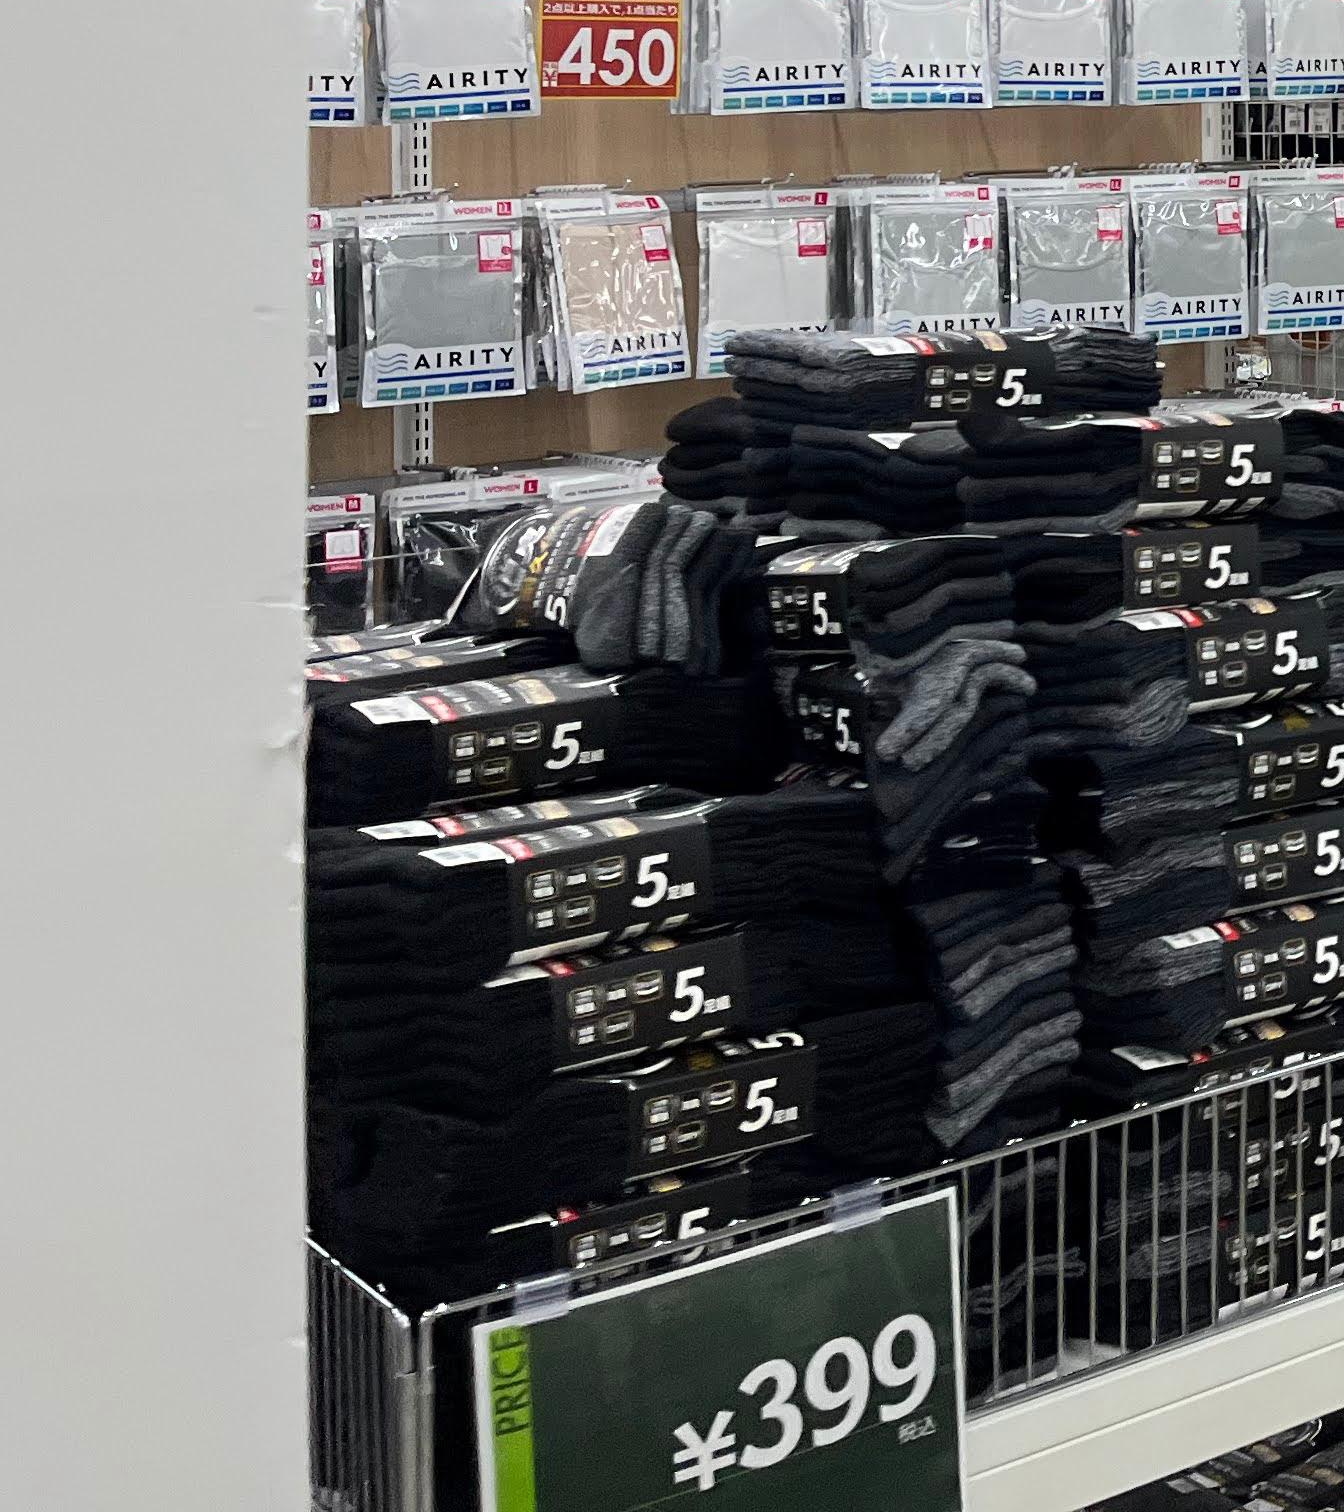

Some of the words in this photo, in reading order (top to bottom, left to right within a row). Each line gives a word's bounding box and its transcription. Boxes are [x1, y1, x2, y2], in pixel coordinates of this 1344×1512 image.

[755, 63, 845, 82] AIRITY
[902, 62, 982, 79] AIRITY
[1027, 62, 1105, 76] AIRITY
[1165, 59, 1241, 76] AIRITY
[427, 68, 528, 90] AIRITY
[1172, 298, 1242, 316] AIRITY
[917, 317, 997, 333] AIRITY
[610, 330, 683, 355] AIRITY
[413, 346, 514, 370] AIRITY
[491, 1326, 529, 1437] PRICE
[673, 1313, 937, 1492] ¥399
